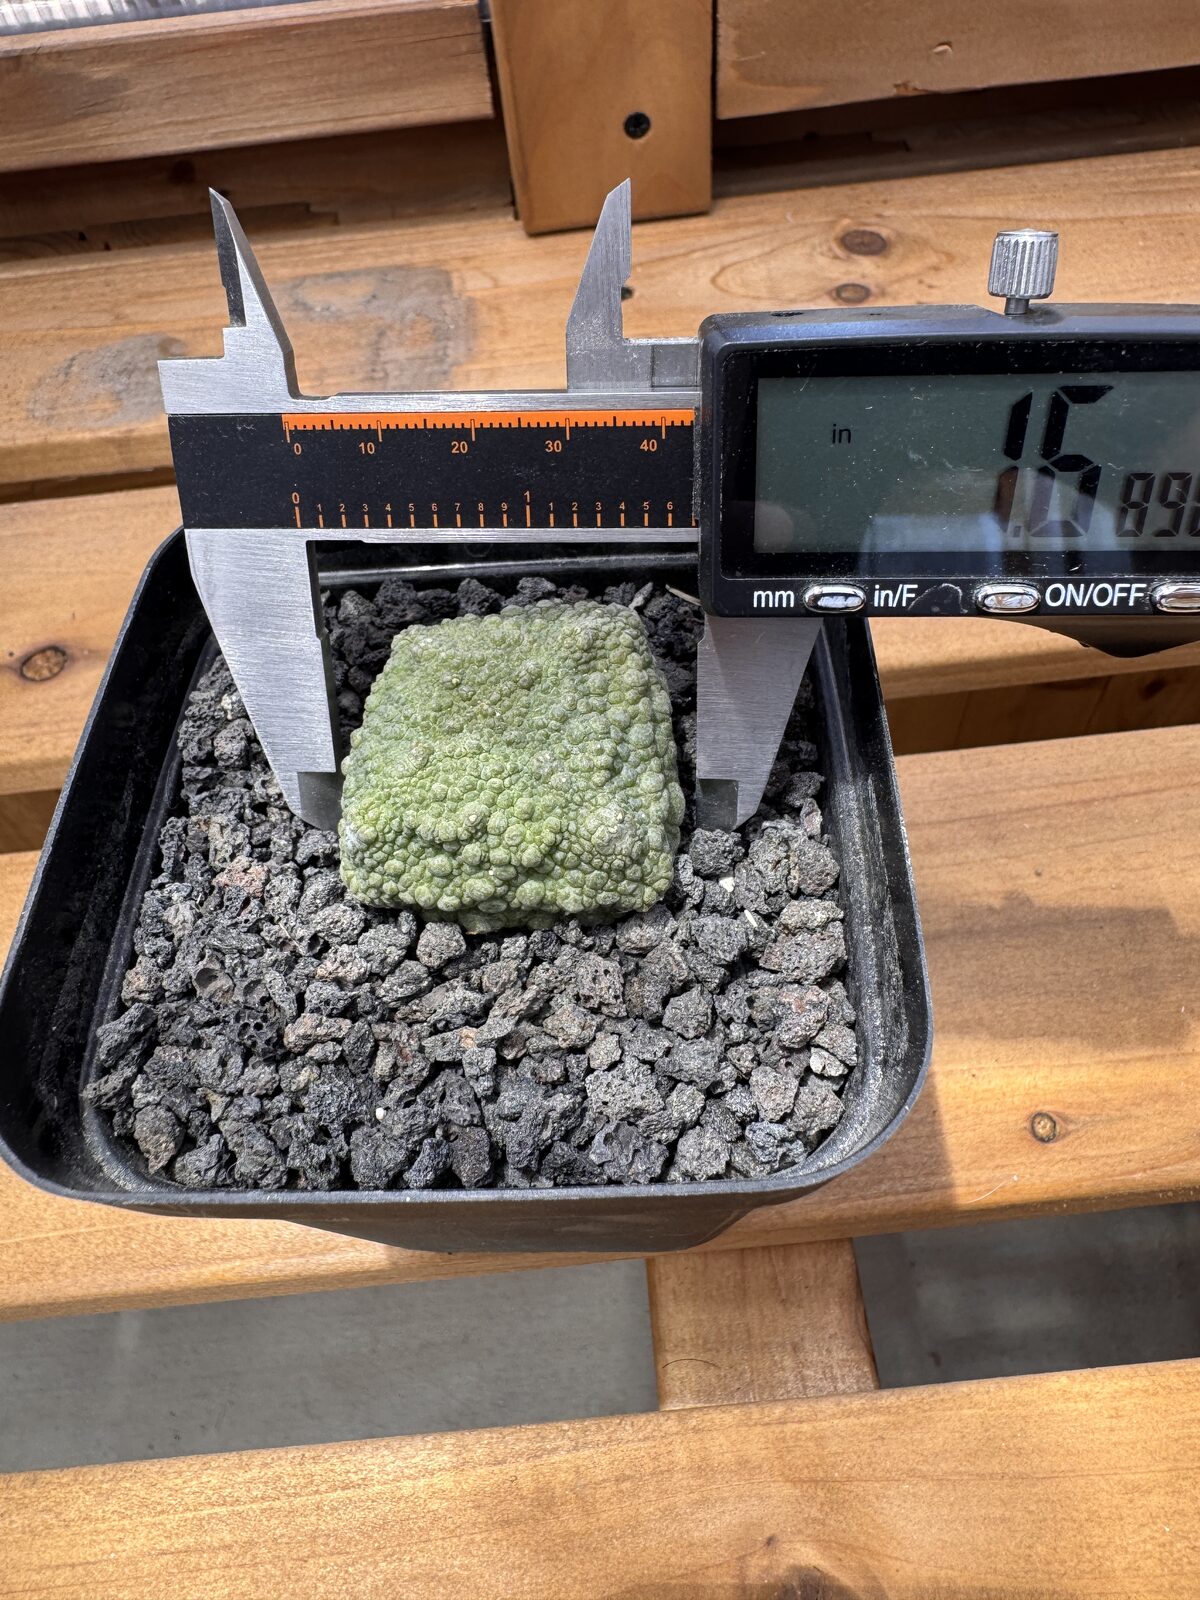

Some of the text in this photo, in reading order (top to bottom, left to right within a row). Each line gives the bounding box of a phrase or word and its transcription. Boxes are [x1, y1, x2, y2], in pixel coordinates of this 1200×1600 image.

[831, 424, 852, 444] in
[293, 439, 657, 455] 0 10 20 30 40
[292, 490, 673, 512] 0 1 2 3 4 5 6 7 8 9 1 1 2 3 4 5 6
[753, 590, 795, 608] mm
[873, 584, 918, 607] in/F
[1045, 583, 1147, 607] ON/OFF
